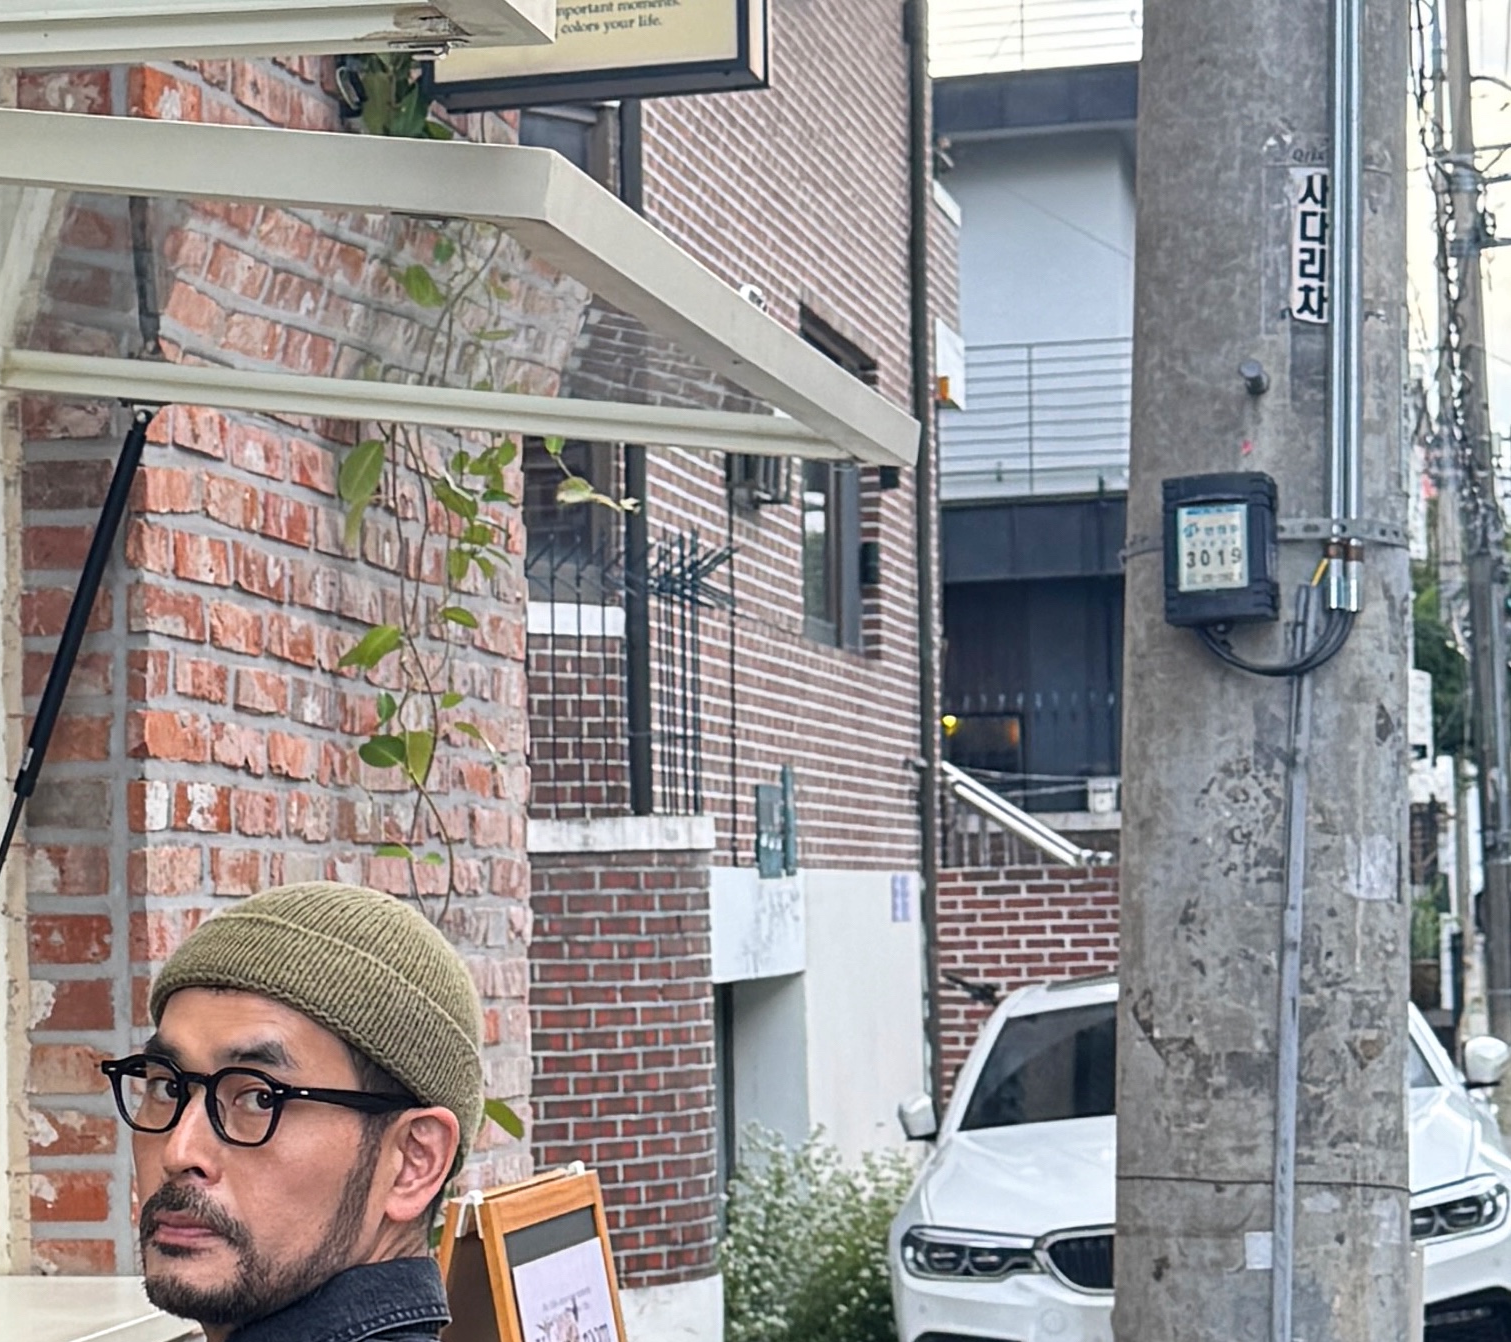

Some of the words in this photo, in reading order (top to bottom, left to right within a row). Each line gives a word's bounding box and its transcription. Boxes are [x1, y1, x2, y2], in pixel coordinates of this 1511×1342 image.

[556, 2, 613, 19] mportant
[560, 21, 600, 34] colors
[603, 18, 634, 34] your
[638, 14, 662, 27] life.
[1296, 173, 1330, 320] 사다리차
